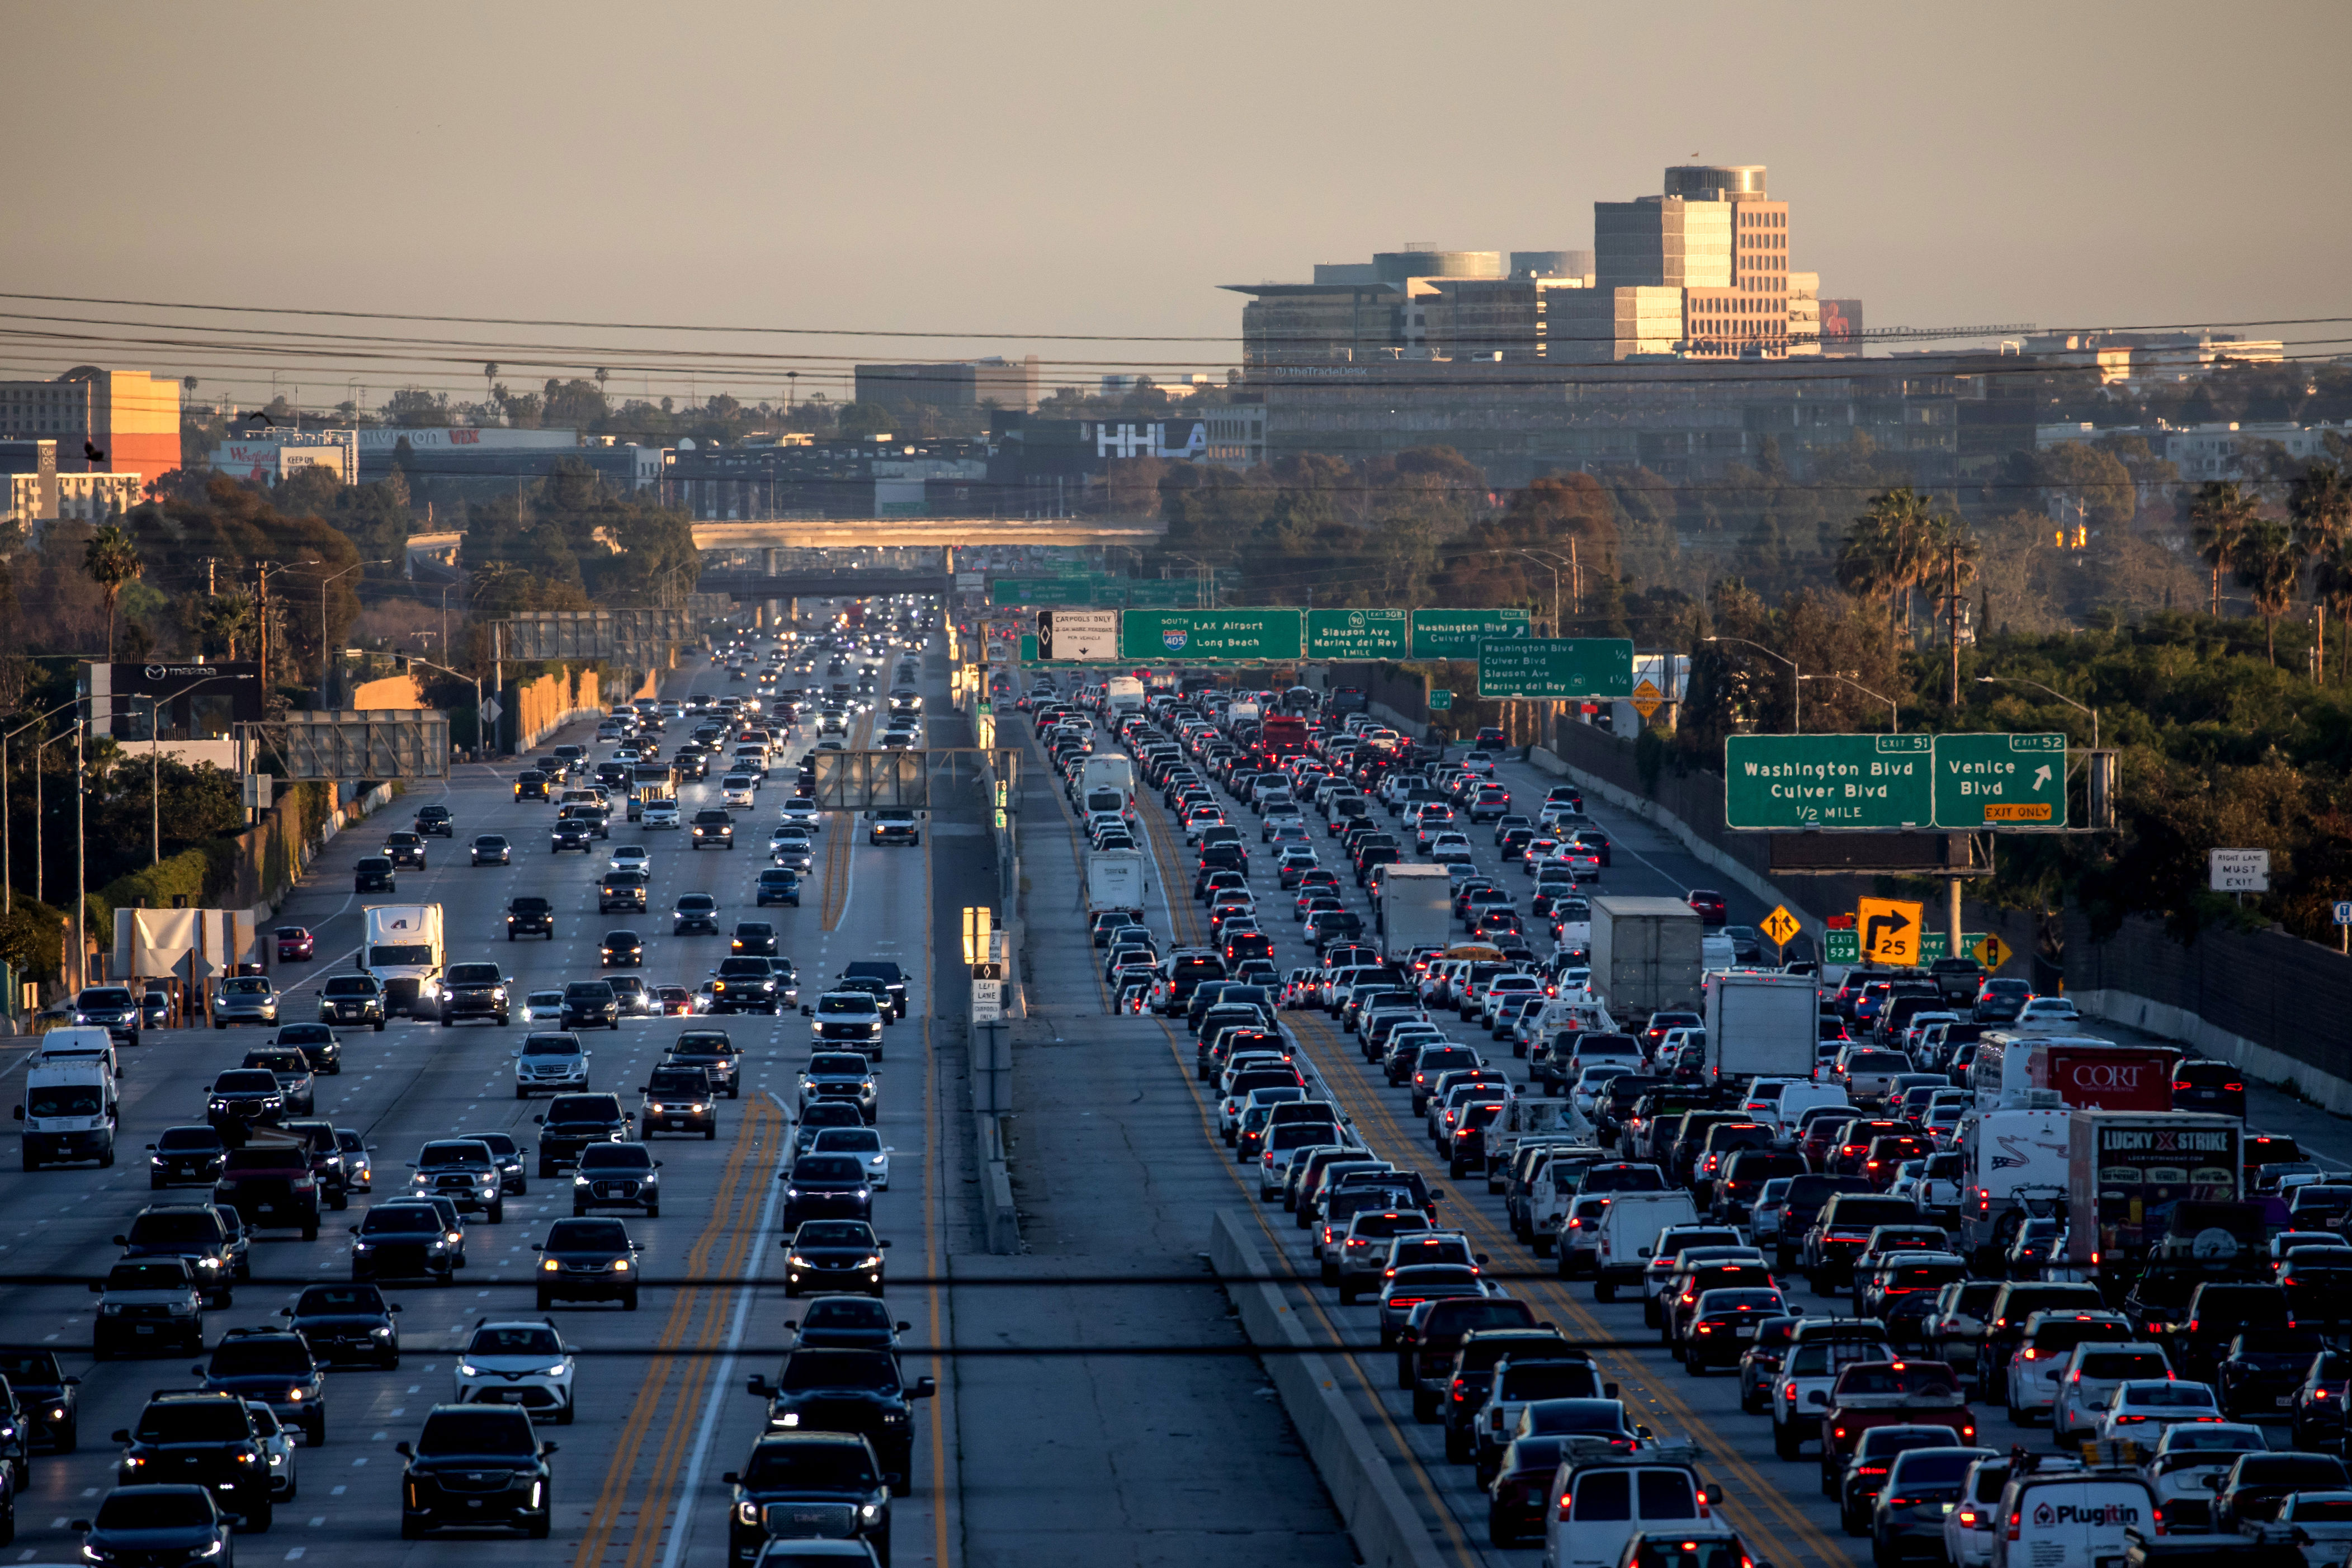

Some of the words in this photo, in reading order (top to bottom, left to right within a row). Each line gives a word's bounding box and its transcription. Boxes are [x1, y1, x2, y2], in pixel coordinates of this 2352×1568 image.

[1097, 423, 1206, 458] HHLA
[287, 456, 303, 465] KEEP
[1194, 622, 1216, 630] LAX
[1223, 622, 1263, 630] Airport
[1418, 623, 1479, 633] Washington
[1484, 623, 1508, 632] Blvd
[1322, 628, 1365, 636] Slauson
[1370, 627, 1390, 636] Ave
[1165, 636, 1184, 645] 405
[1197, 639, 1223, 648] Long
[1228, 638, 1259, 646] Beach
[1378, 639, 1397, 648] Rey
[1430, 634, 1465, 643] Culver
[1343, 649, 1347, 657] 1
[1485, 644, 1546, 654] Washington
[1523, 657, 1546, 665] Blvd
[169, 667, 216, 676] mazda
[1485, 669, 1526, 678] Slauson
[1532, 669, 1550, 678] Ave
[1485, 682, 1520, 691] Marina
[1526, 682, 1542, 690] del
[1547, 682, 1566, 692] Rey
[1914, 737, 1928, 749] 51
[2042, 737, 2062, 748] 52
[1745, 762, 1859, 780] Washington
[1870, 762, 1913, 776] Blvd
[1948, 759, 2015, 774] Venice
[1771, 783, 1835, 798] Culver
[1845, 784, 1887, 798] Blvd
[1961, 781, 2002, 795] Blvd
[1796, 805, 1817, 820] 1/2
[1825, 807, 1862, 818] MILE
[1986, 807, 2013, 818] EXIT
[2018, 807, 2051, 818] ONLY
[2226, 878, 2254, 886] EXIT
[1830, 935, 1854, 944] EXIT
[1881, 939, 1906, 955] 25
[1922, 941, 1945, 950] ver
[1830, 948, 1844, 957] 52
[2073, 1065, 2143, 1087] CORT
[2104, 1130, 2153, 1150] LUCKY
[2178, 1131, 2228, 1151] STRIKE
[2057, 1504, 2138, 1527] Plugitin
